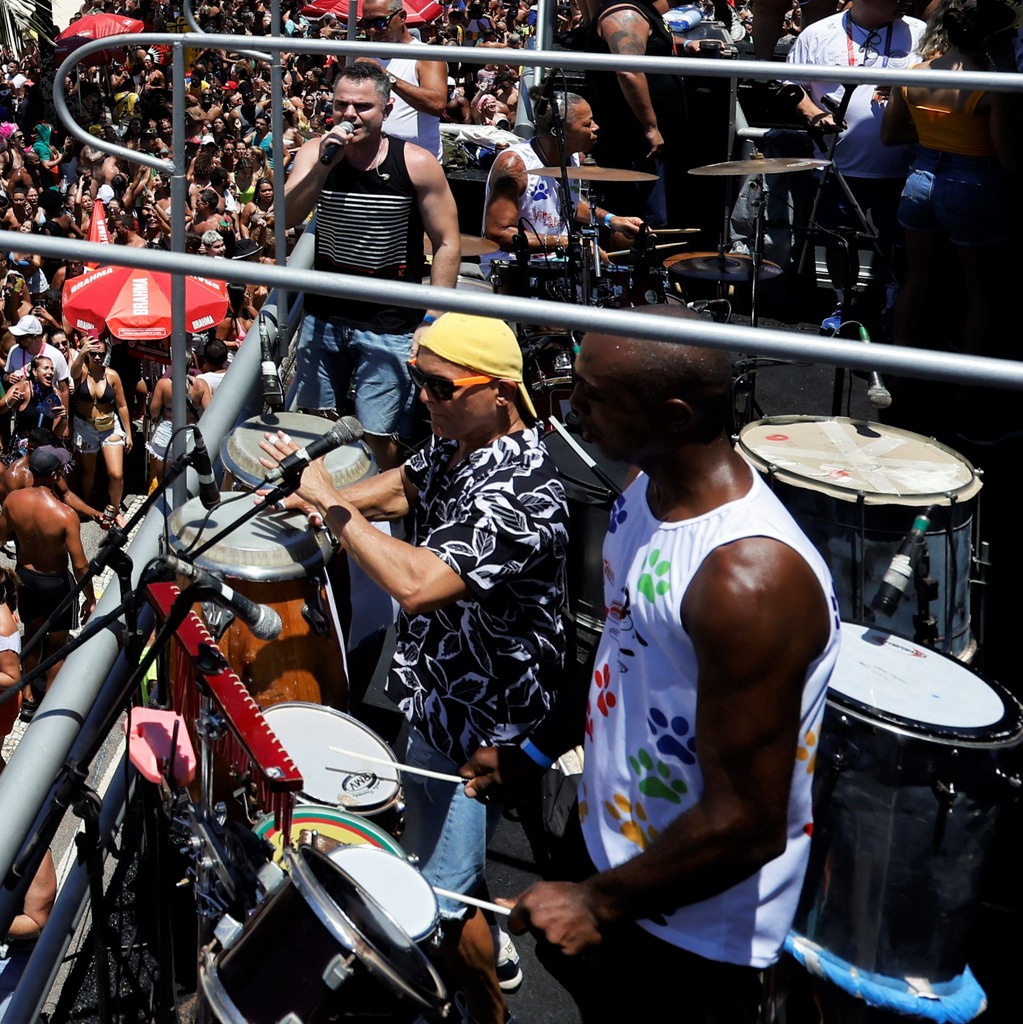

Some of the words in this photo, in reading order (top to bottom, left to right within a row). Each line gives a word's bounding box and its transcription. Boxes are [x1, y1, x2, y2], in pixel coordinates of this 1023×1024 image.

[70, 267, 113, 294] BRAHMA
[132, 278, 149, 315] BRAHMA
[192, 315, 215, 330] BRAHMA
